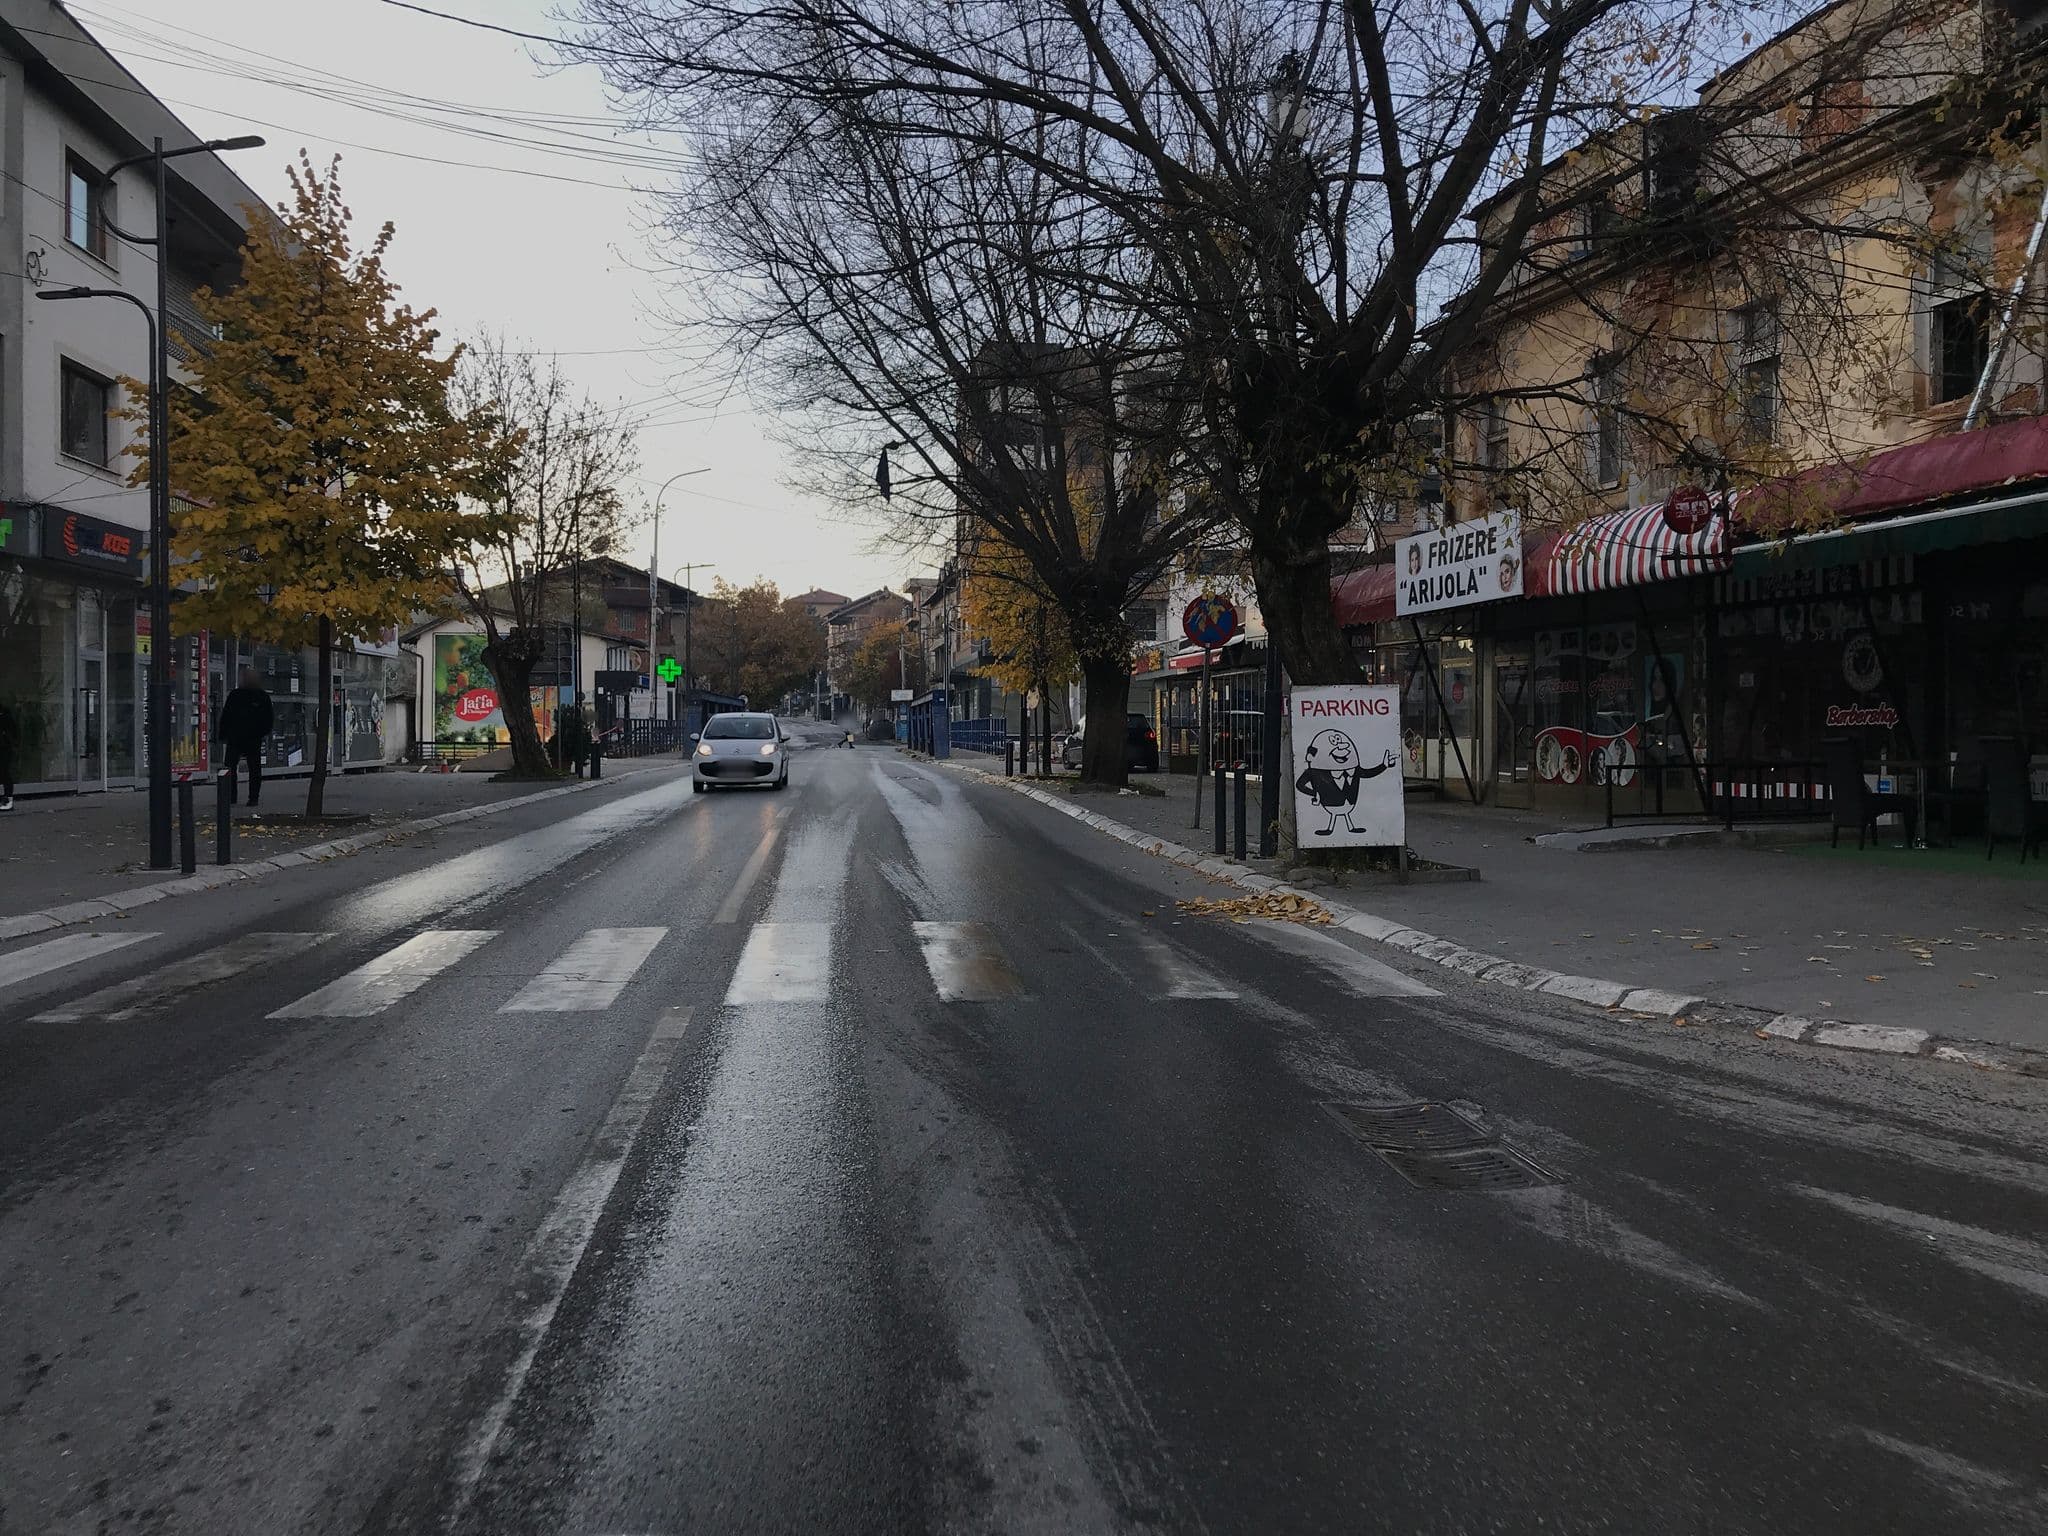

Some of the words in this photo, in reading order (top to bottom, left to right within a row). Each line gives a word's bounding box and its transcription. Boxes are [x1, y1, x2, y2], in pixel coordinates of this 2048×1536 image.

[1428, 526, 1498, 568] FRIZERE
[1399, 566, 1487, 606] "ARIJOLA"
[460, 695, 493, 715] Jaffa
[1301, 699, 1390, 717] PARKING
[1826, 702, 1901, 730] Barbershop
